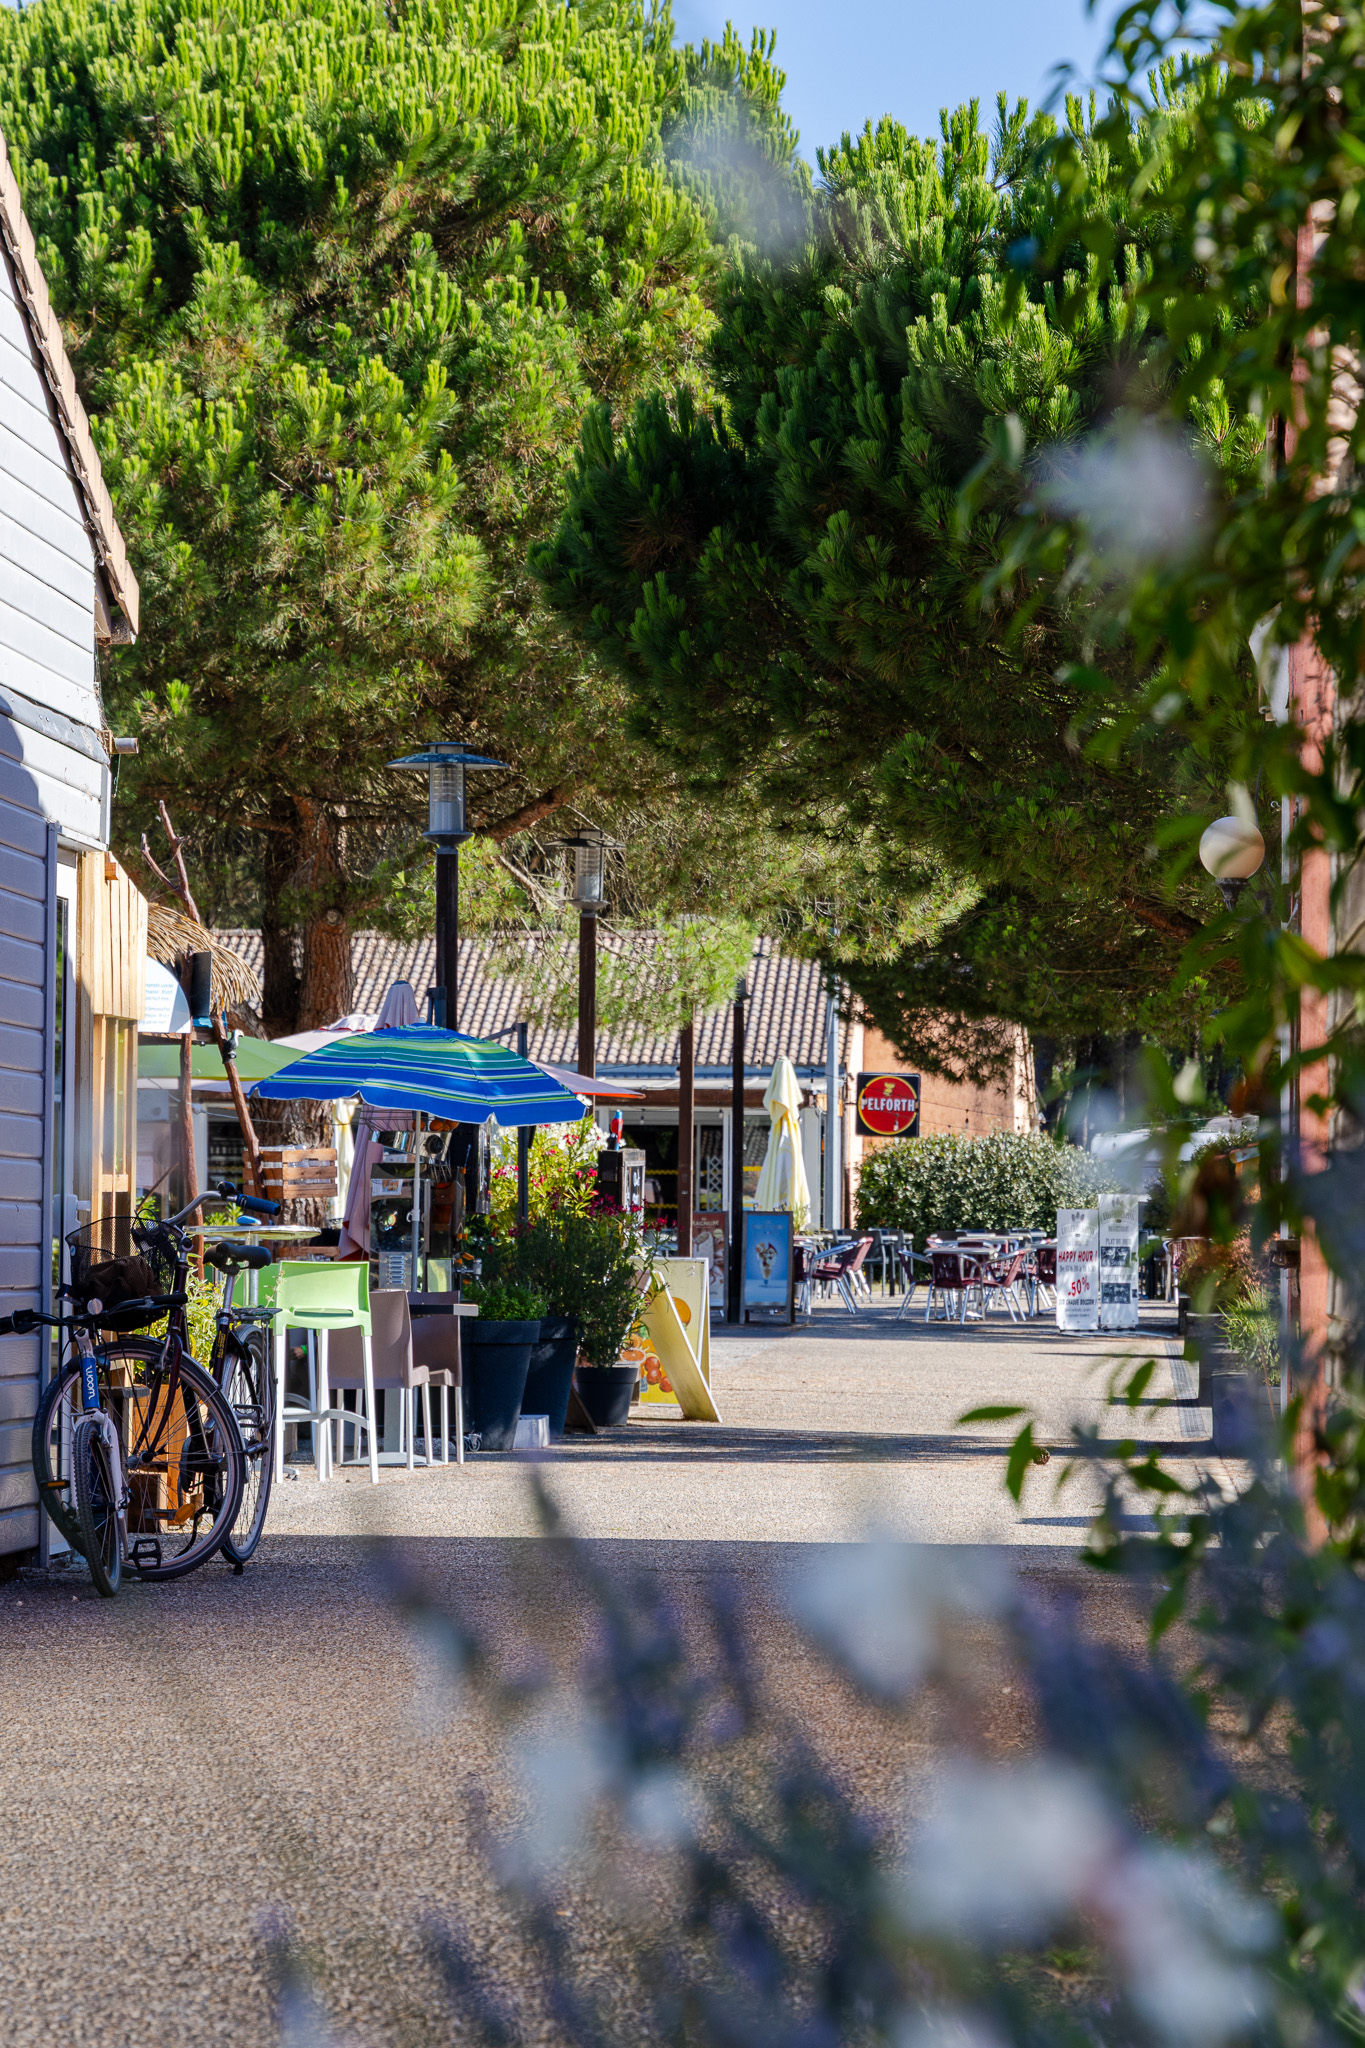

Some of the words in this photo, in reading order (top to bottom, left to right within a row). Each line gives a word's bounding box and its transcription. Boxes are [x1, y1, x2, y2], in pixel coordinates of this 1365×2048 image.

[861, 1097, 915, 1112] PELFORTH
[1058, 1250, 1076, 1262] HAPPY
[1078, 1250, 1093, 1262] HOUR
[1068, 1275, 1090, 1297] -50%
[85, 1365, 96, 1400] woom
